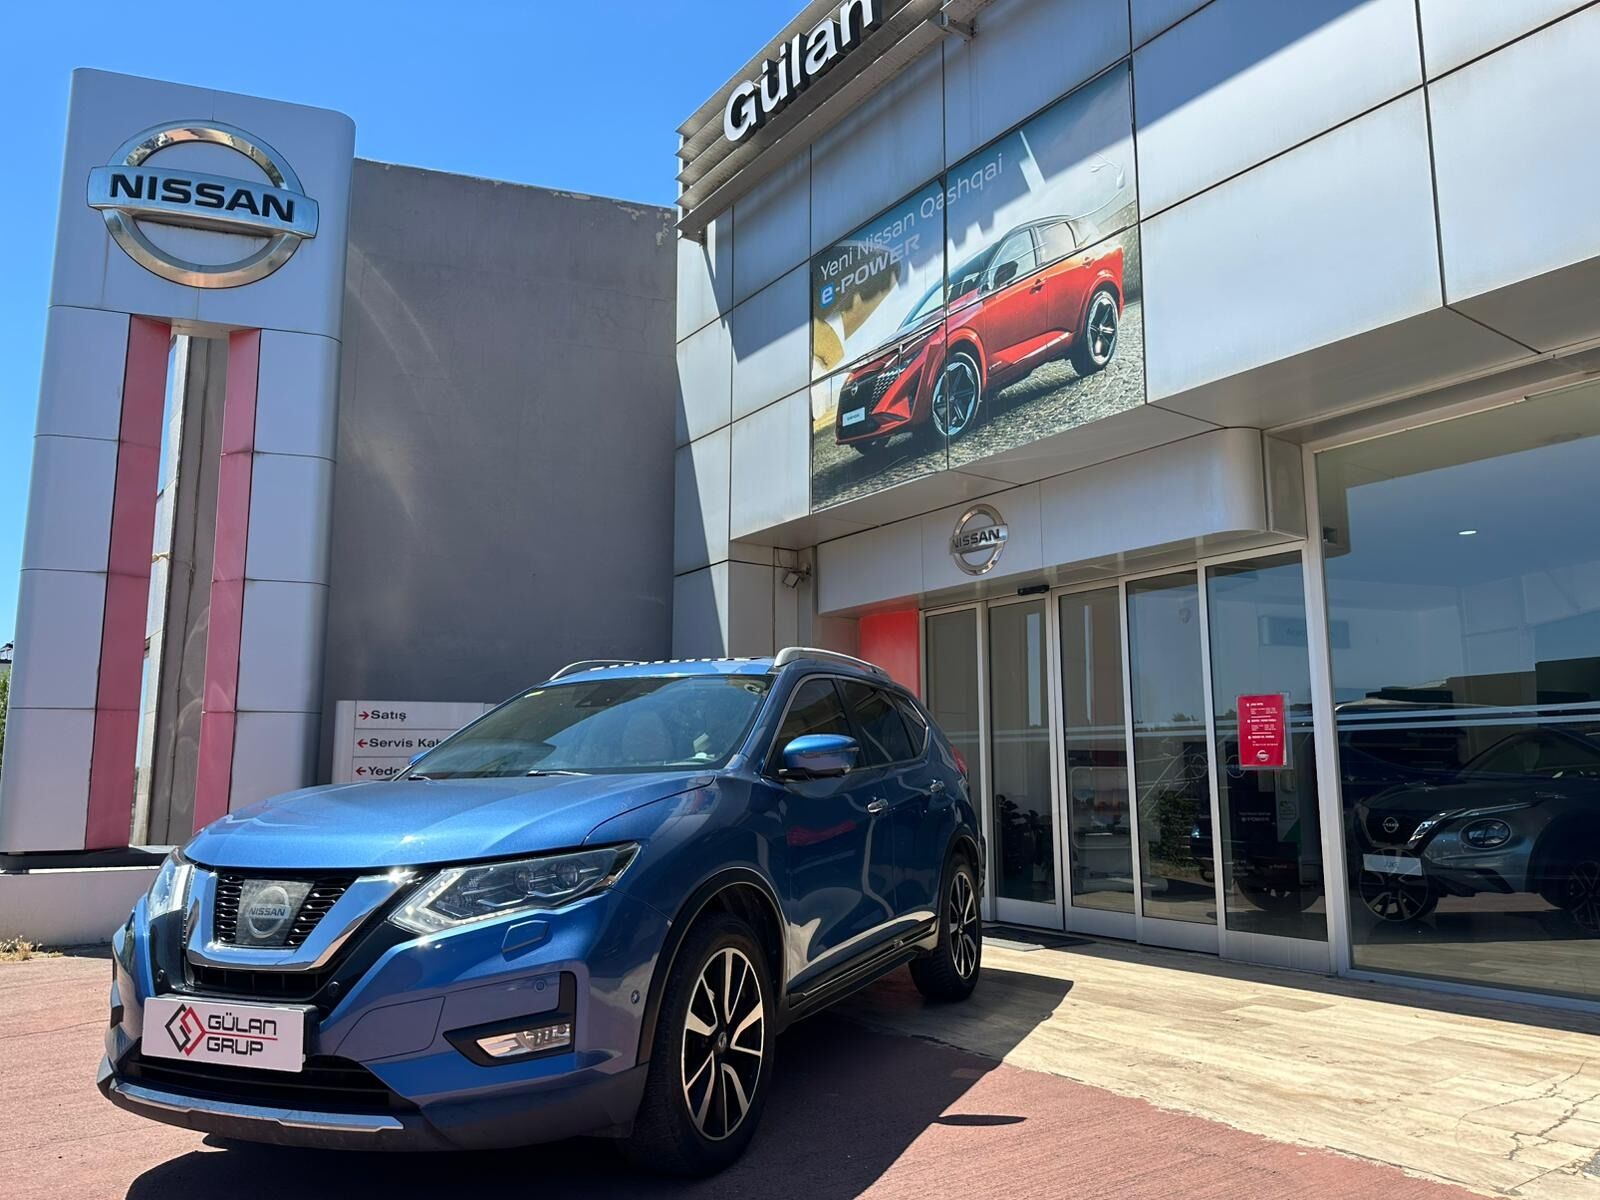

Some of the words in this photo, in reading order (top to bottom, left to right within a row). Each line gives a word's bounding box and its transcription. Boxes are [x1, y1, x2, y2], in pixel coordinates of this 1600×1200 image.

[724, 0, 873, 141] Gülan
[110, 173, 296, 223] NISSAN
[820, 247, 853, 281] Yeni
[857, 212, 915, 259] Nissan
[920, 153, 1003, 219] Qashqai
[820, 233, 921, 306] e-POWER
[953, 528, 1000, 548] NISSAN
[370, 710, 407, 722] Satış
[369, 738, 413, 748] Servis
[249, 907, 286, 917] NISSAN
[207, 1012, 277, 1036] GÜLAN
[206, 1036, 264, 1056] GRUP
